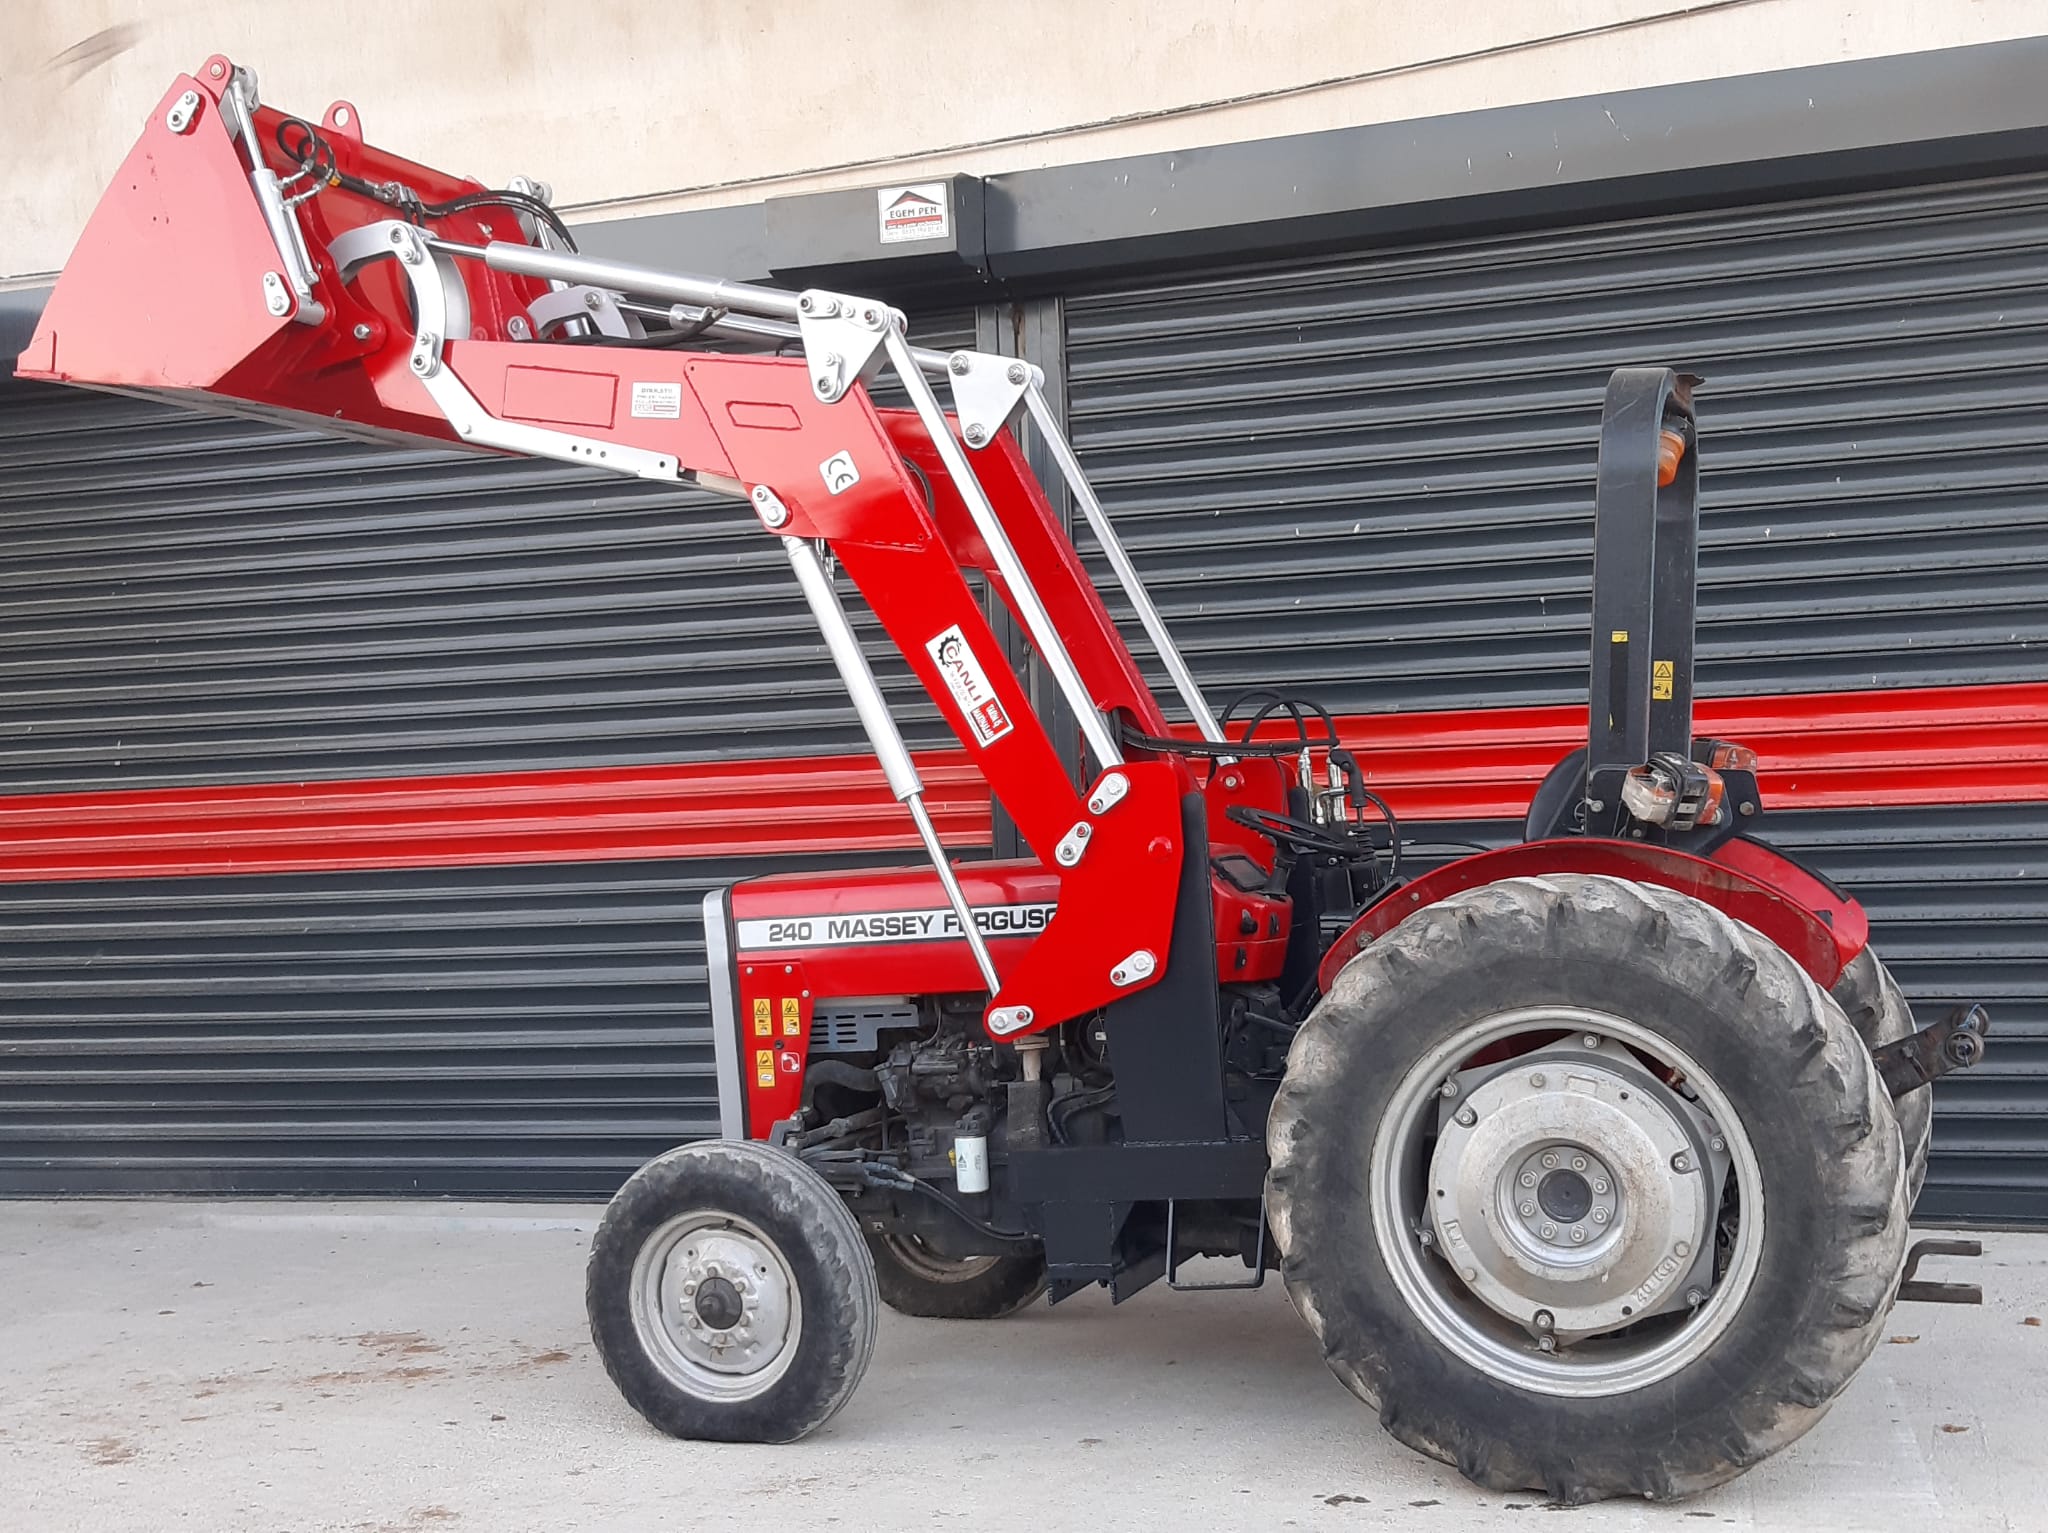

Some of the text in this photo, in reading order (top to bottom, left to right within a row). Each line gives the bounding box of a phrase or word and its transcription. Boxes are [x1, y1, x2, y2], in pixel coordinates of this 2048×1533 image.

[889, 206, 937, 218] EGEM PEN
[828, 458, 854, 489] CE
[945, 644, 982, 702] CANLI
[769, 907, 1057, 942] 240 MASSEY FRGUS
